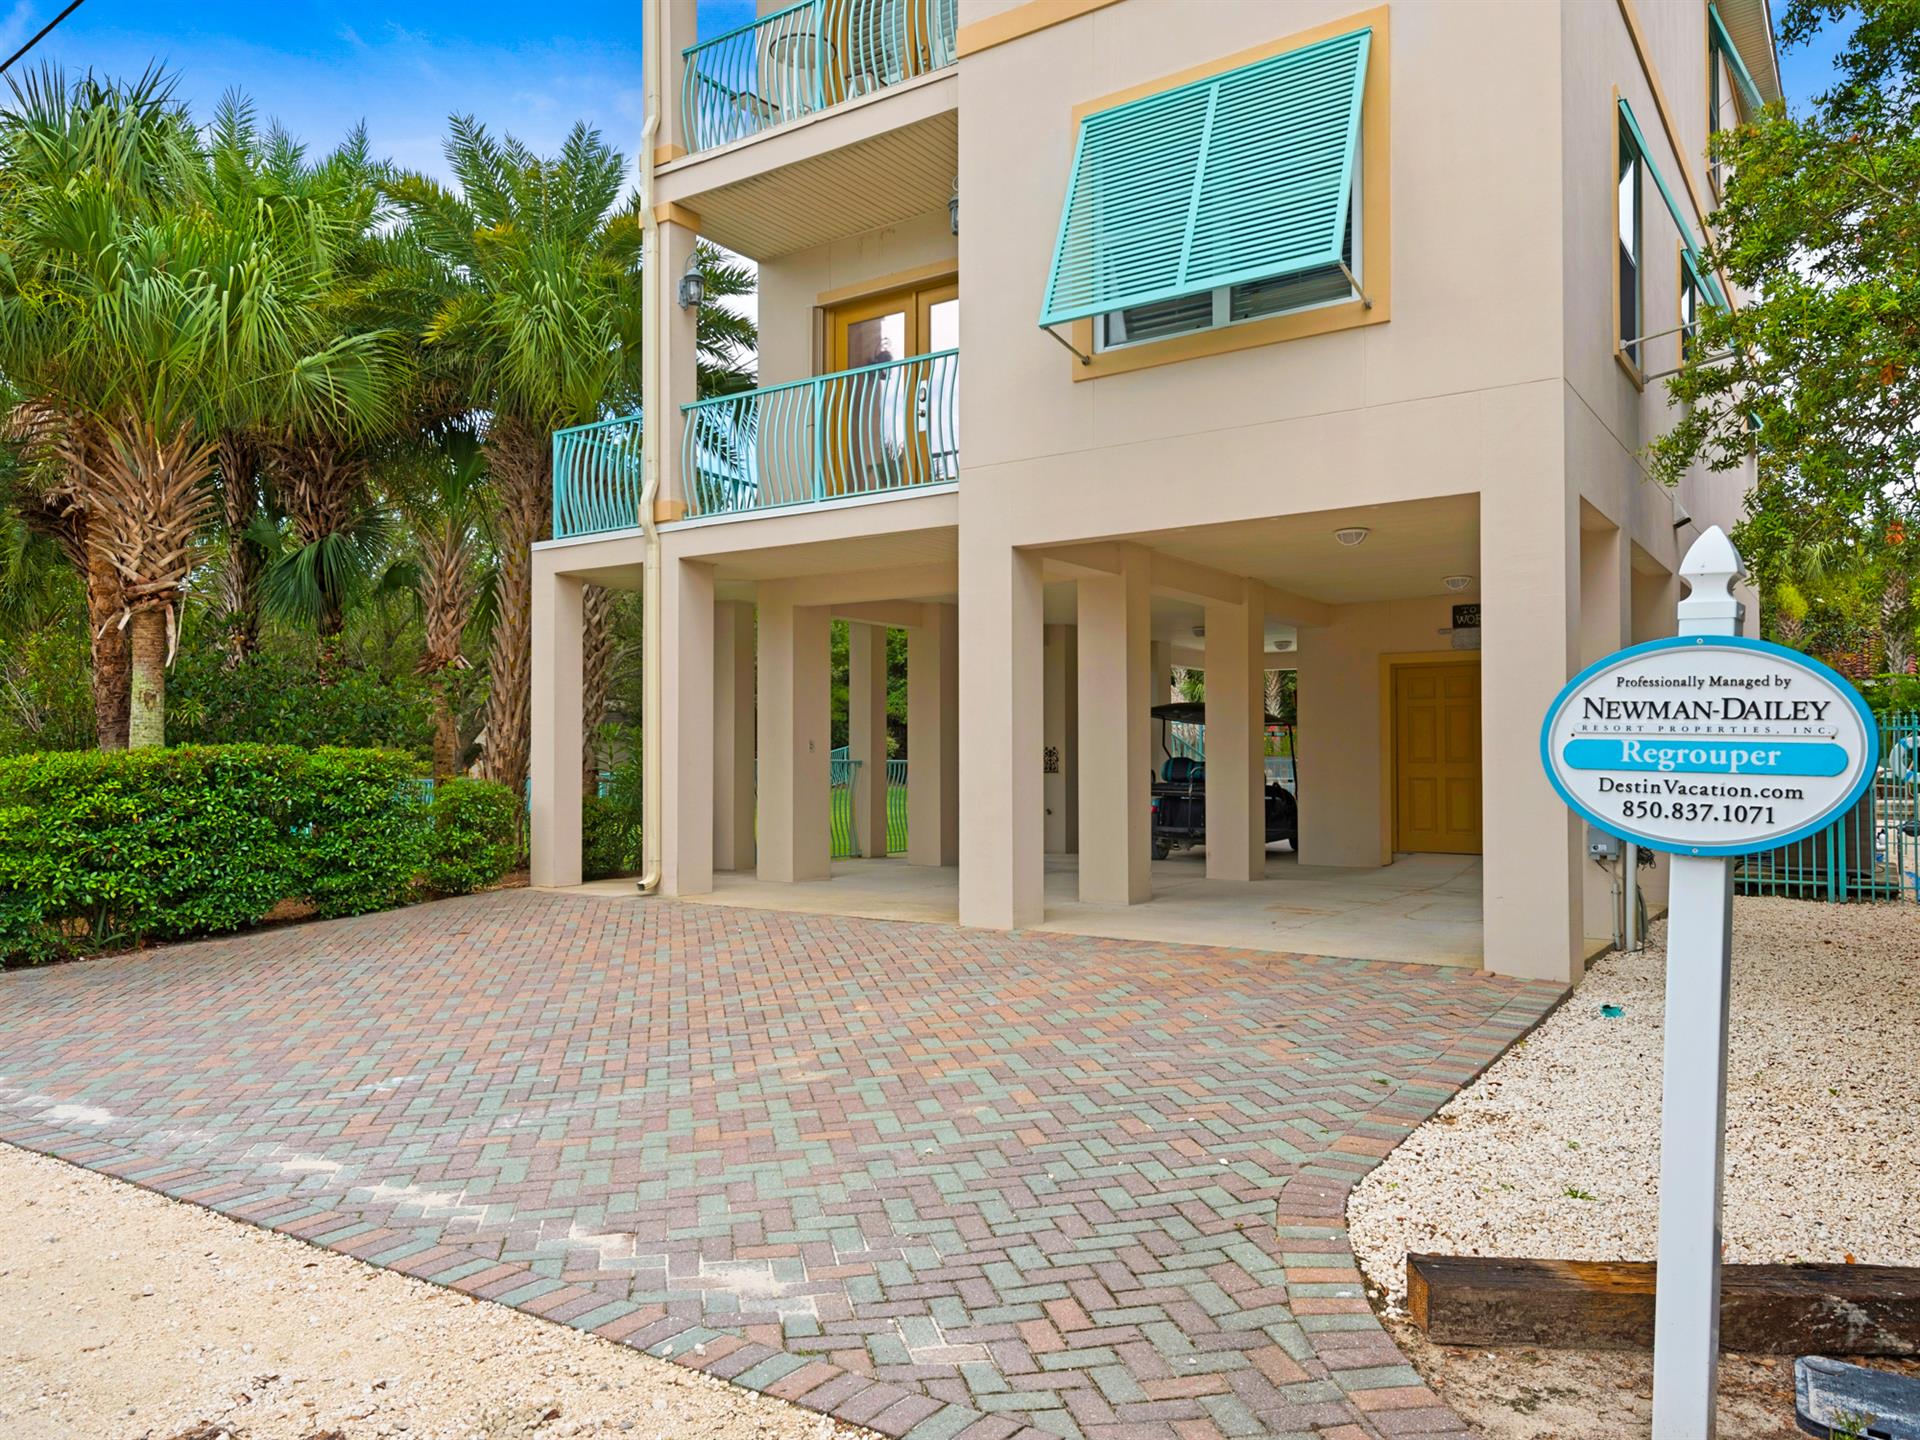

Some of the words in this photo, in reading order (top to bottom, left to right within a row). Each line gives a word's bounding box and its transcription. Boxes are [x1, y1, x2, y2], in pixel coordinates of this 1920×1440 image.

[1617, 675, 1705, 690] Professionally
[1709, 675, 1770, 690] Managed
[1774, 674, 1792, 690] by
[1583, 697, 1831, 721] NEWMAN-DAILEY
[1658, 726, 1780, 734] PROPERTIES,
[1793, 727, 1832, 735] INC.
[1620, 739, 1782, 773] Regrouper
[1598, 777, 1805, 800] DestinVacation.com
[1622, 800, 1776, 825] 850.837.1071
